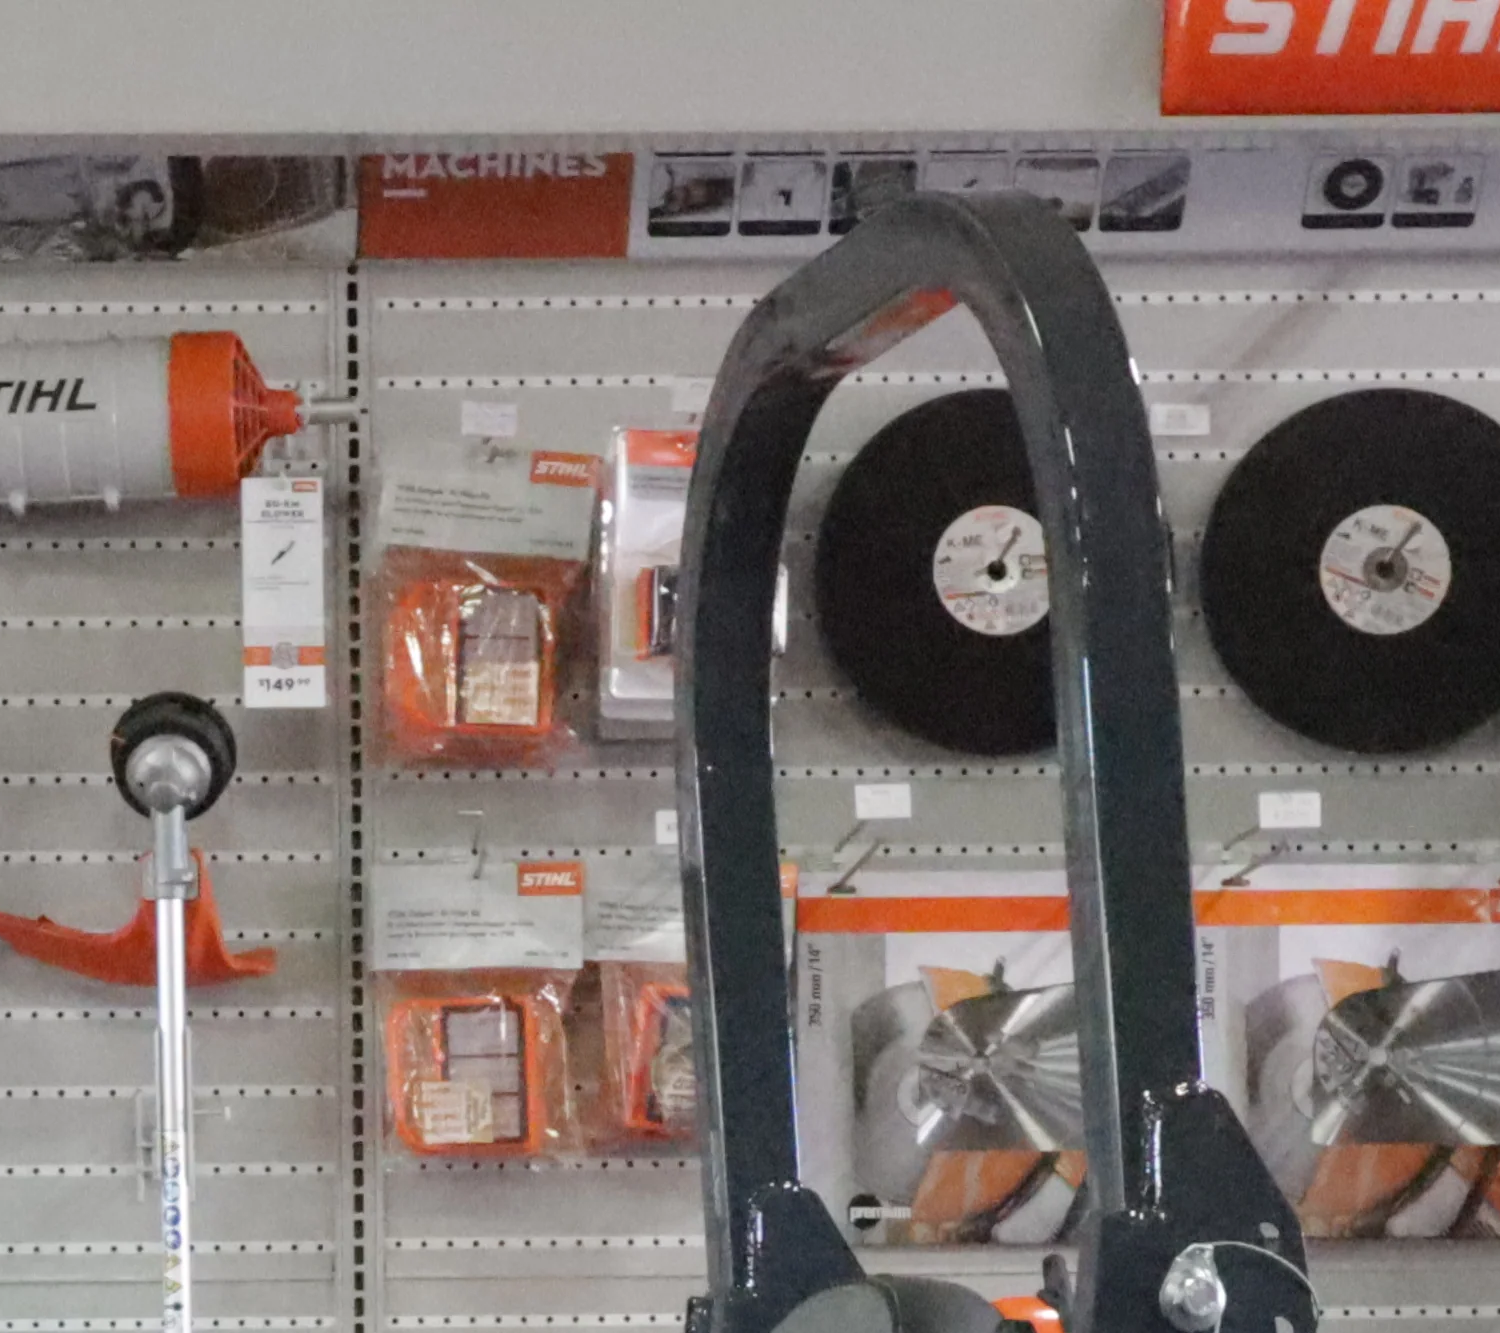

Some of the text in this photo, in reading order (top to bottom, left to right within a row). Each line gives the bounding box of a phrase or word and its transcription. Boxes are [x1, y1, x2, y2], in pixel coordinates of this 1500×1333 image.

[383, 153, 607, 178] MACHINES
[534, 460, 590, 478] STIHL
[521, 871, 577, 887] STIHL
[850, 1207, 912, 1223] premium
